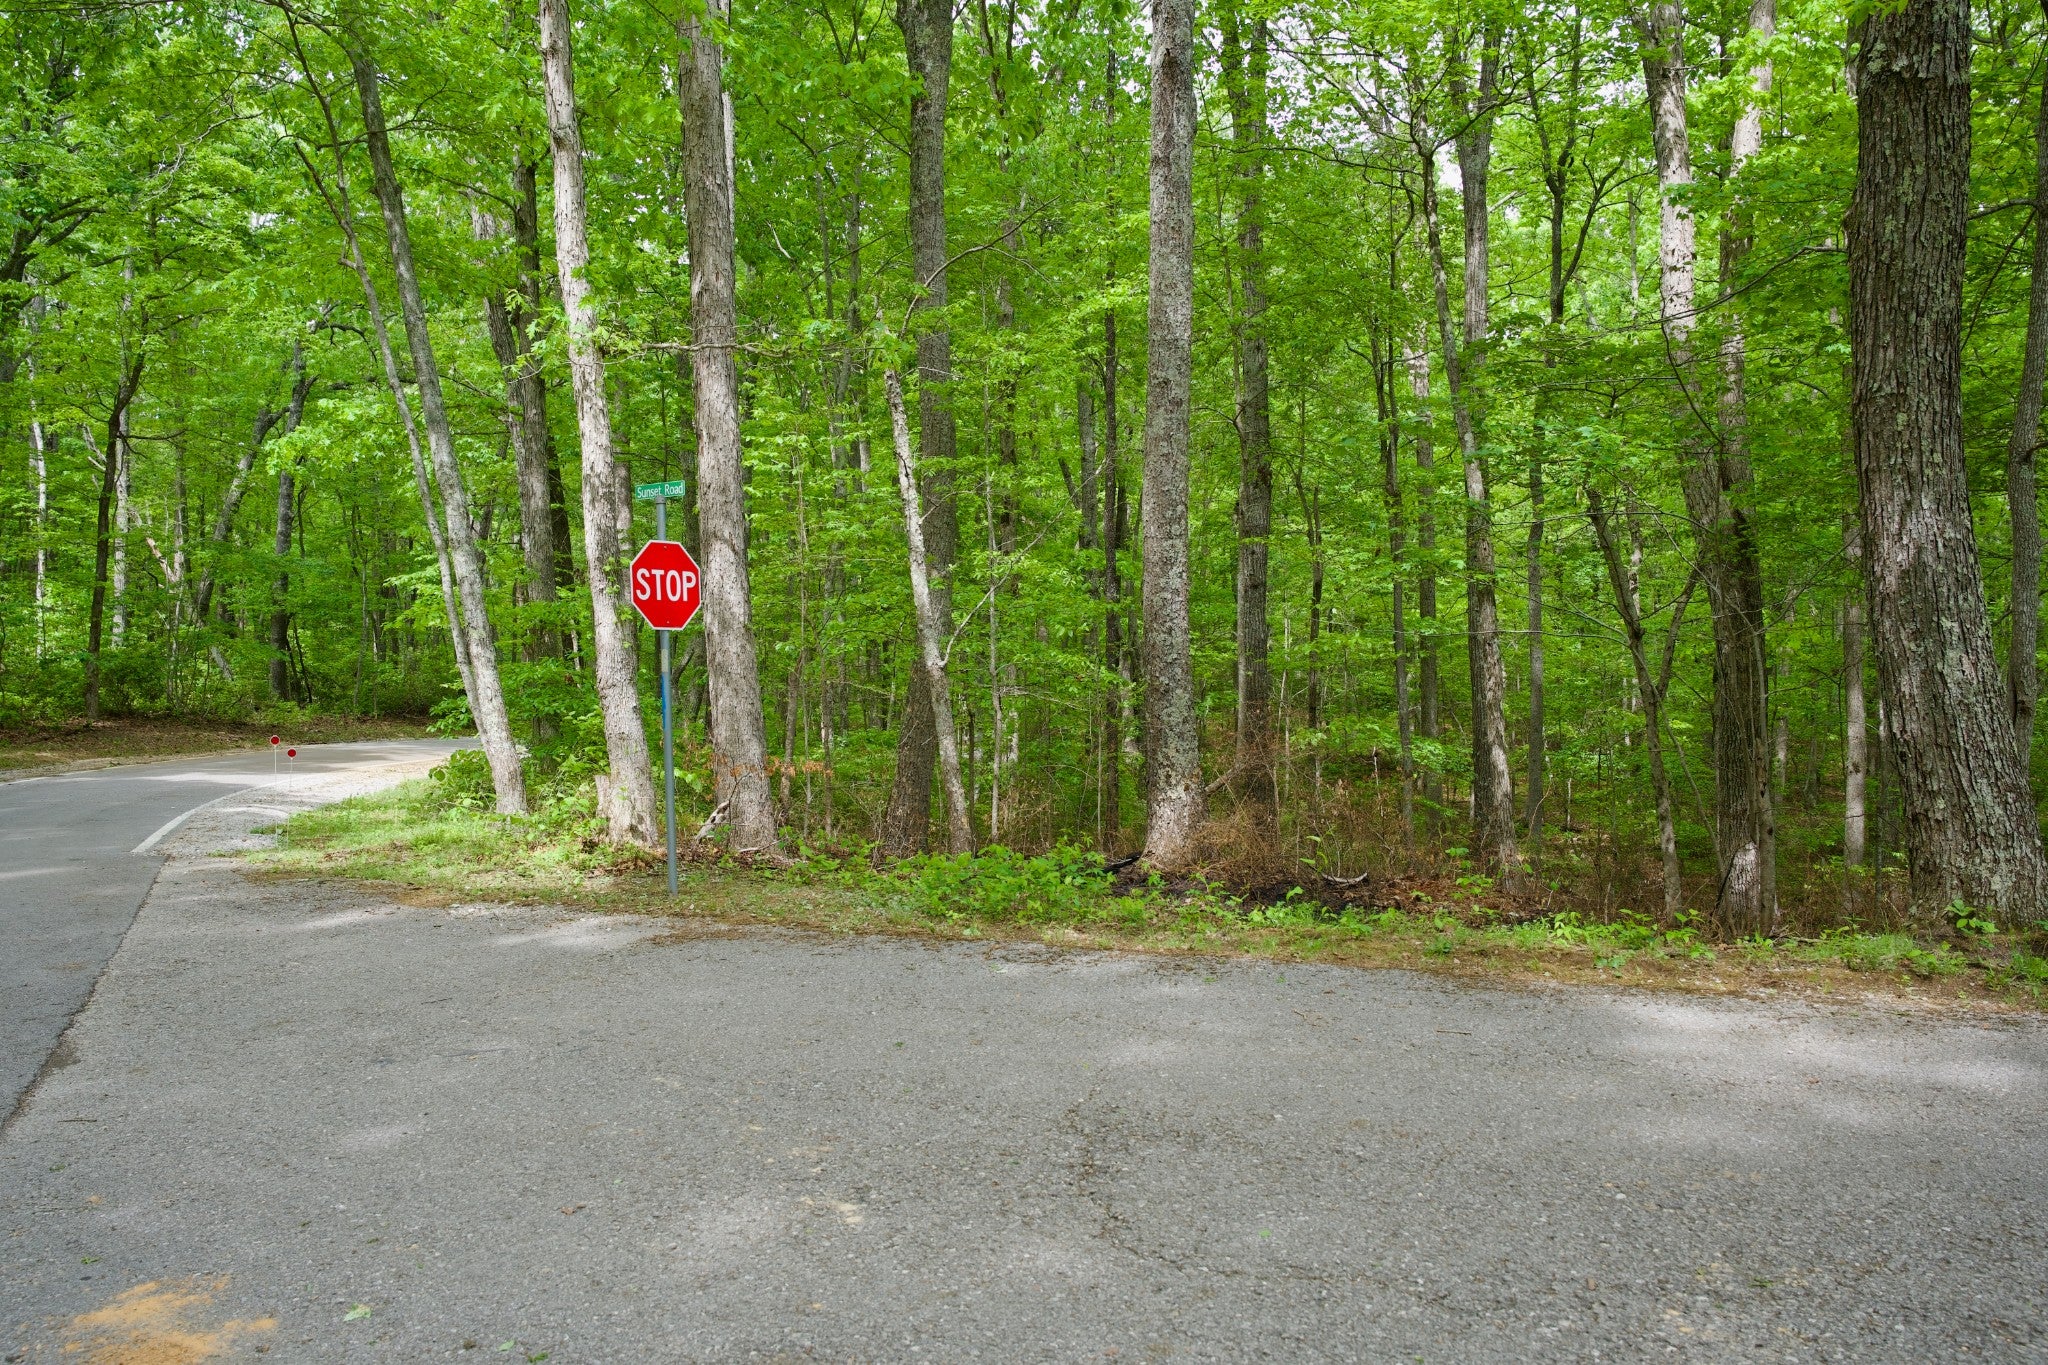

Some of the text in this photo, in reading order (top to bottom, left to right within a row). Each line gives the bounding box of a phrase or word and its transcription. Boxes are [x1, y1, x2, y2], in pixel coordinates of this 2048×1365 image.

[637, 481, 683, 498] Sunset Road
[636, 568, 697, 602] STOP
